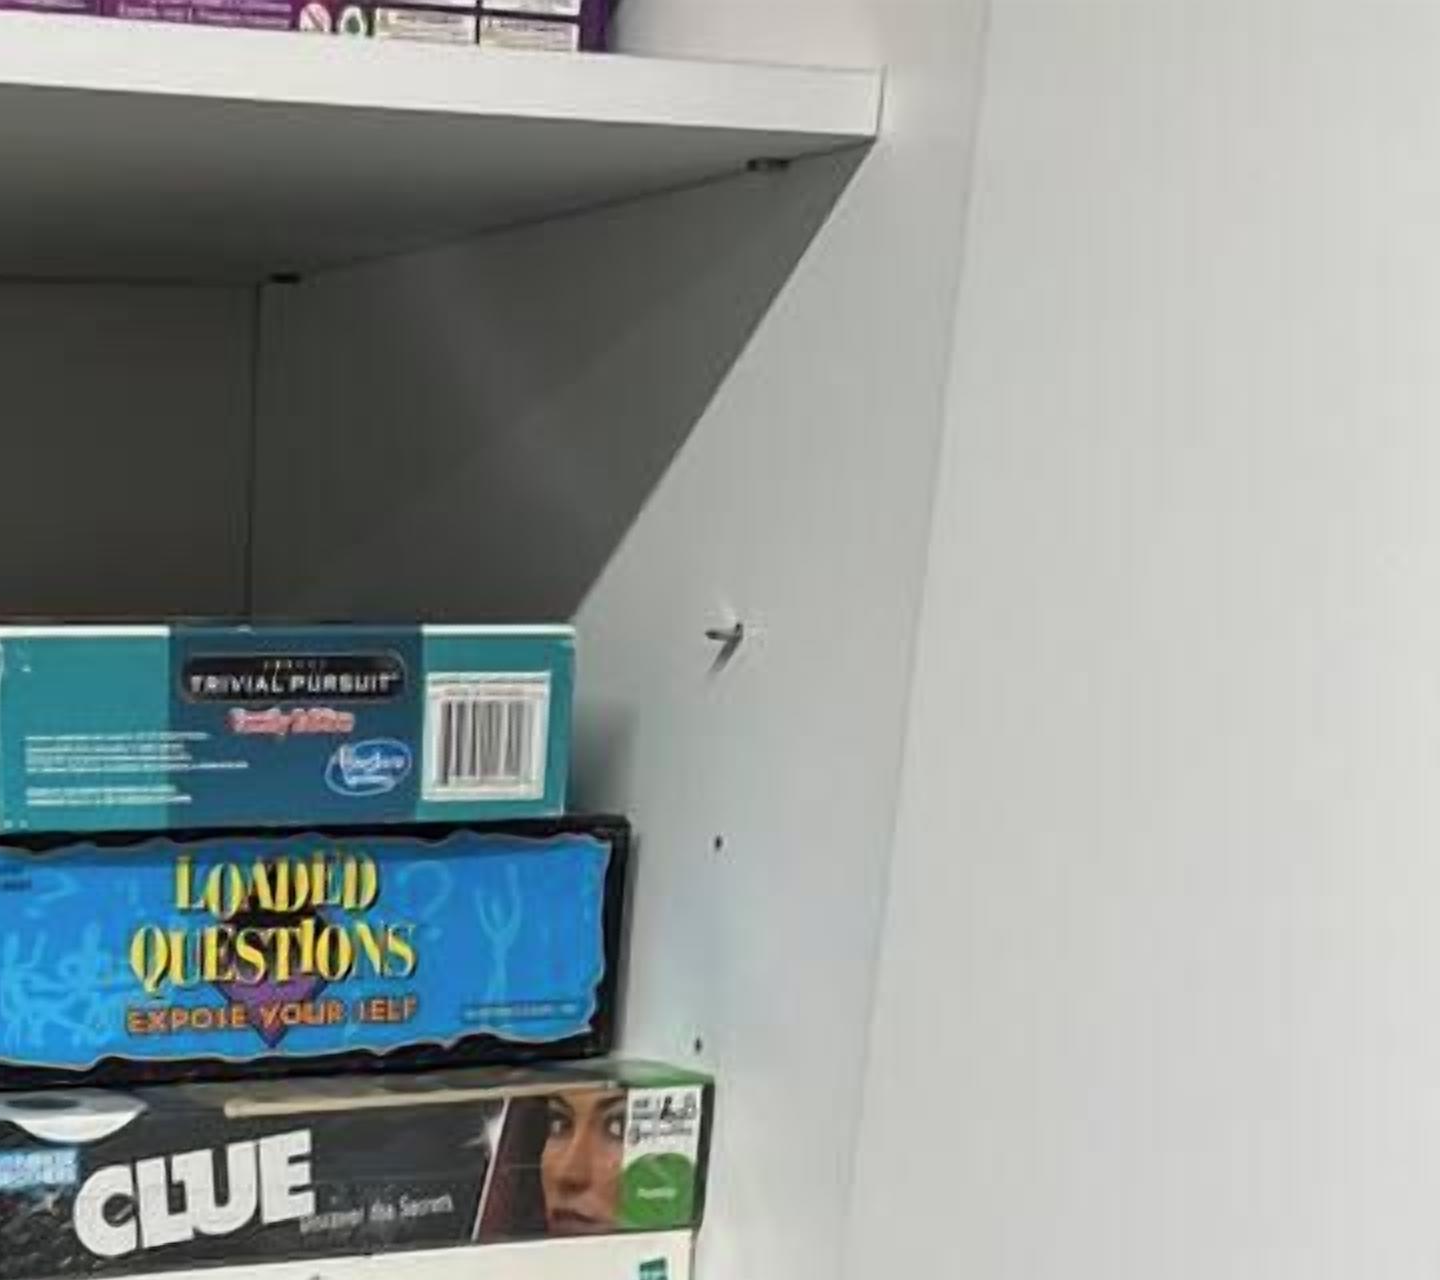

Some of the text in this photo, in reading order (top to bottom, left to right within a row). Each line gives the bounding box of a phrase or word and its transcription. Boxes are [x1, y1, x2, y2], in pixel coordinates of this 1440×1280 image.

[189, 672, 393, 694] TRIVIAL PURSUIT
[174, 853, 378, 919] LOADED
[129, 917, 418, 994] QUESTIONS
[259, 1000, 345, 1028] YOUR
[73, 1128, 316, 1257] CLUE
